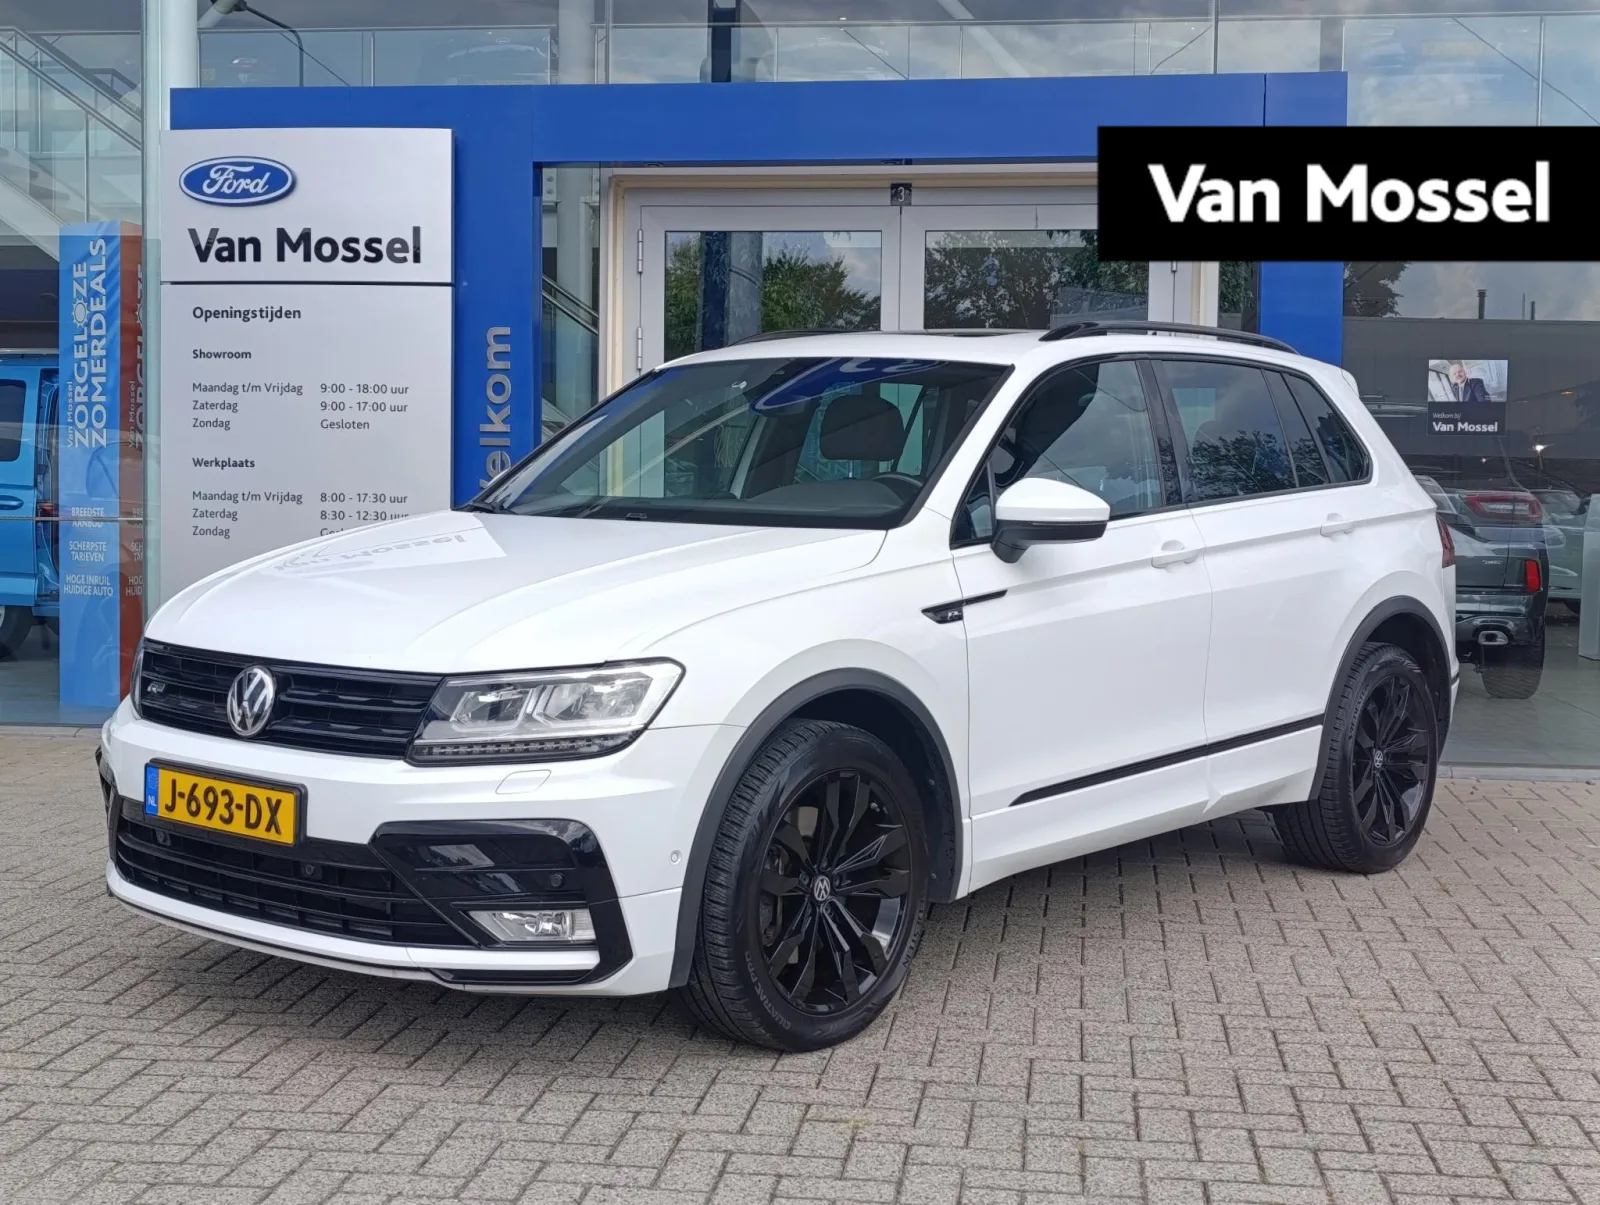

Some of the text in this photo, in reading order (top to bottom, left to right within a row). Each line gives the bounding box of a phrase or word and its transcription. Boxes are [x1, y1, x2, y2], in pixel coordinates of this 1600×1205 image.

[202, 164, 271, 194] Ford
[897, 186, 905, 202] 3
[187, 225, 421, 264] Van Mossel
[192, 306, 301, 322] Openingstijden
[90, 238, 107, 448] ZOMERDEALS
[192, 348, 252, 359] Showroom
[192, 382, 303, 396] Maandag t/m Vrijdag
[320, 383, 346, 394] 9:00
[356, 383, 388, 394] 18:00
[390, 385, 409, 394] uur
[192, 400, 239, 413] Zaterdag
[320, 401, 346, 412] 9:00
[356, 402, 387, 412] 17:00
[390, 403, 408, 412] uur
[479, 326, 511, 489] elkom
[192, 418, 231, 431] Zondag
[320, 418, 370, 430] Gesloten
[1432, 421, 1498, 432] Van Mossel
[192, 457, 255, 470] Werkplaats
[192, 490, 303, 505] Maandag t/m Vrijdag
[320, 492, 346, 503] 8:00
[356, 493, 386, 503] 17:30
[389, 495, 408, 504] uur
[71, 507, 104, 517] BREEDSTE
[192, 508, 238, 521] Zaterdag
[320, 510, 346, 521] 8:30
[356, 511, 387, 521] 12:30
[192, 526, 230, 539] Zondag
[69, 541, 107, 552] SCHERPSTE
[71, 551, 105, 562] TARIEVEN
[66, 574, 111, 586] HOGE INRUIL
[128, 576, 143, 585] HOG
[63, 584, 113, 597] HUIDIGE AUTO
[126, 587, 143, 596] HUID
[147, 794, 158, 807] NL
[165, 778, 282, 836] J-693-DX
